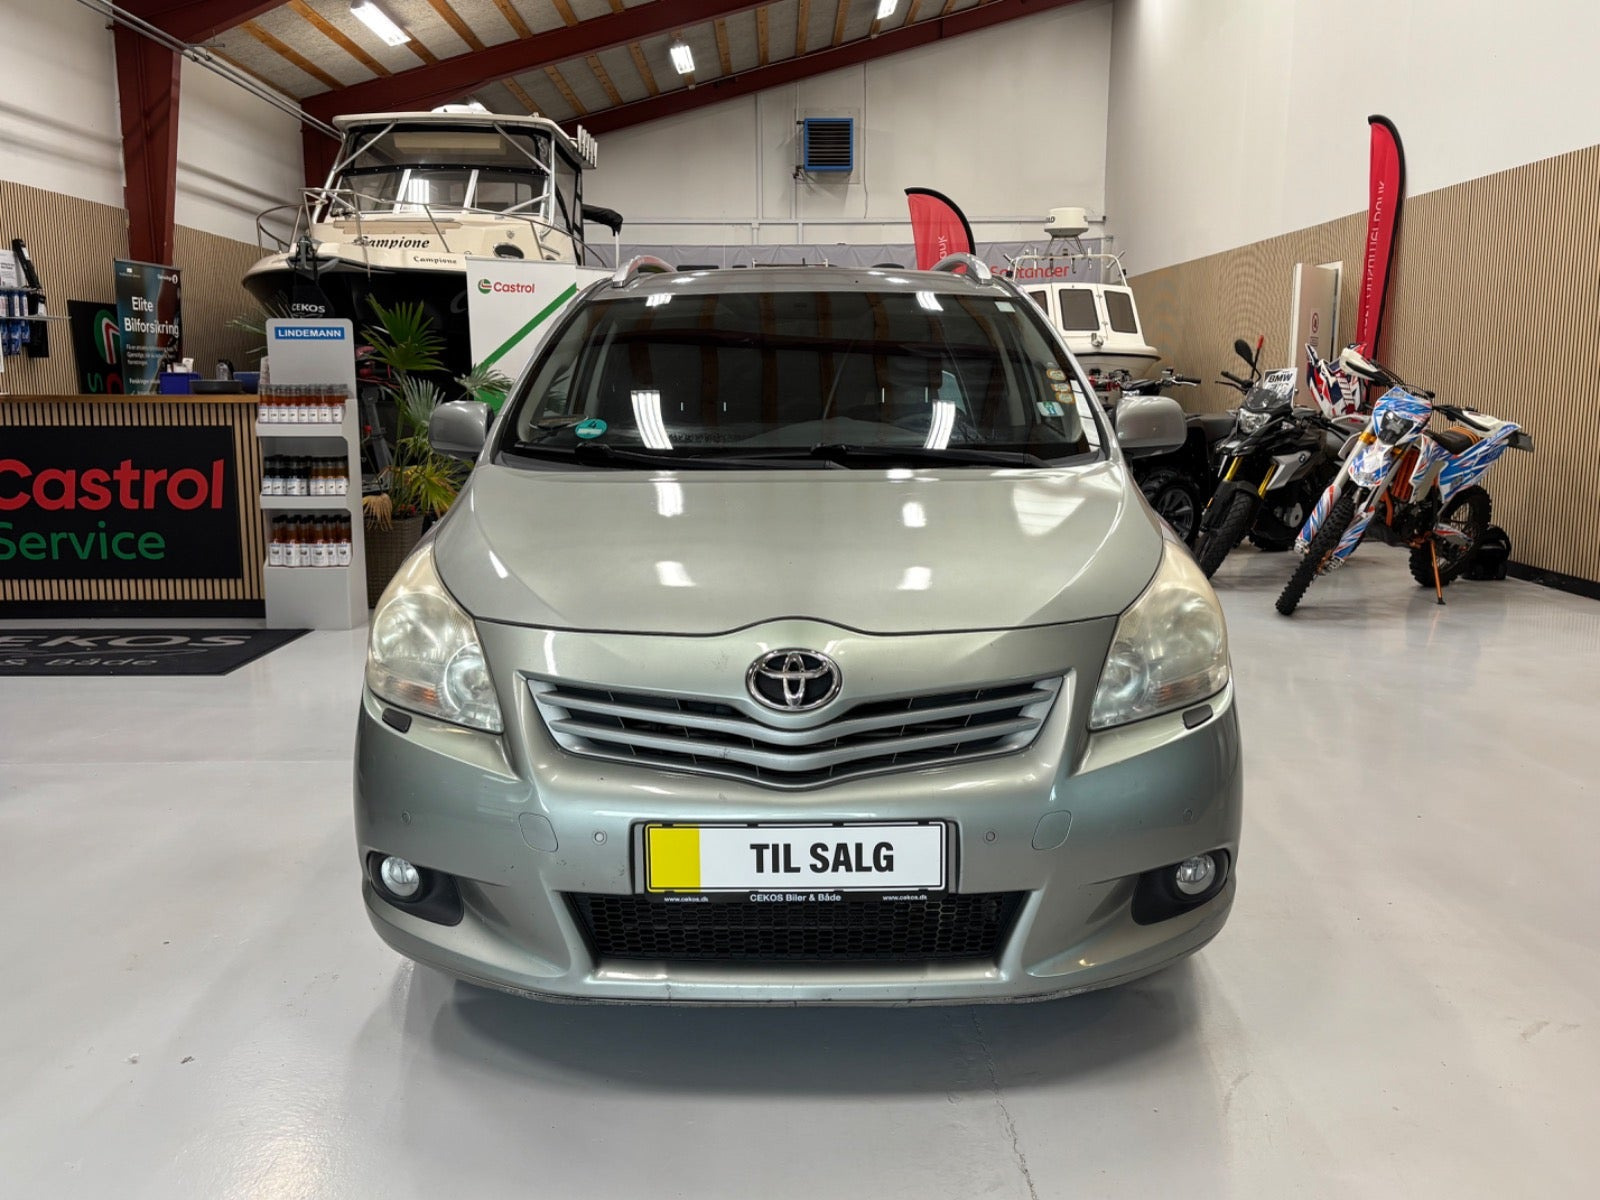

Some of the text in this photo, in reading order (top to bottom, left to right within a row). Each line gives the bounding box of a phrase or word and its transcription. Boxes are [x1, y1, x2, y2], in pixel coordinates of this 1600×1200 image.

[413, 255, 457, 265] Campione
[493, 281, 535, 294] Castrol
[131, 296, 154, 312] Elite
[291, 303, 326, 313] CEKOS
[123, 317, 179, 338] Bilforsikring
[278, 329, 342, 338] LINDEMANN
[1268, 373, 1293, 383] BMW
[0, 458, 225, 511] Castrol
[0, 521, 166, 561] Service
[0, 635, 252, 648] EKOS
[750, 842, 894, 873] TIL SALG
[750, 893, 842, 902] CEKOS Biler & Både
